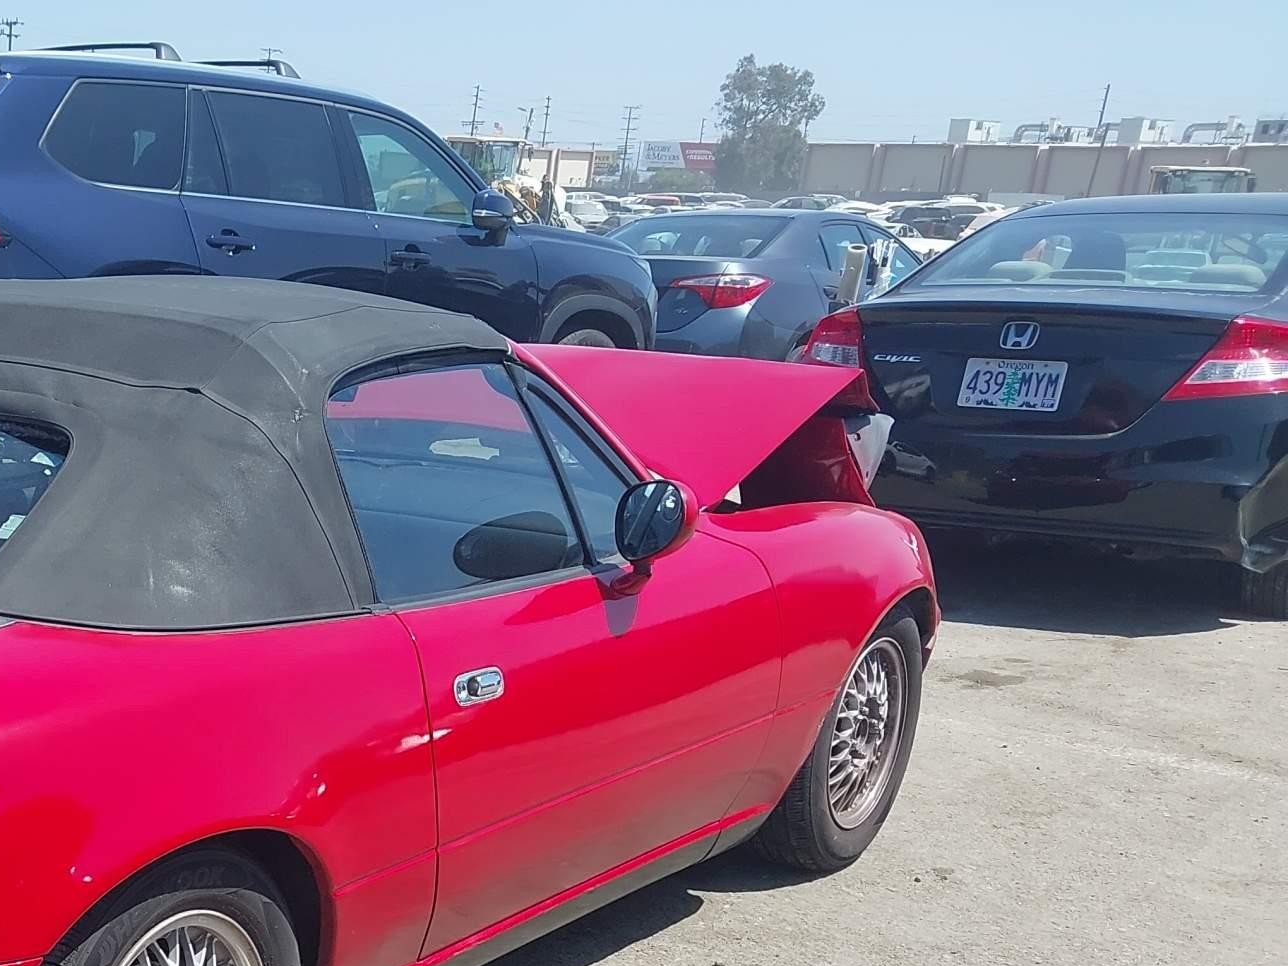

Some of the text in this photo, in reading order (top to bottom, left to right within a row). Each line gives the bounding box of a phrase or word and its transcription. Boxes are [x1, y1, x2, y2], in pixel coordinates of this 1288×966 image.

[873, 354, 921, 363] CIVIC
[998, 360, 1034, 371] Oregon
[966, 369, 1060, 398] 439 MYM
